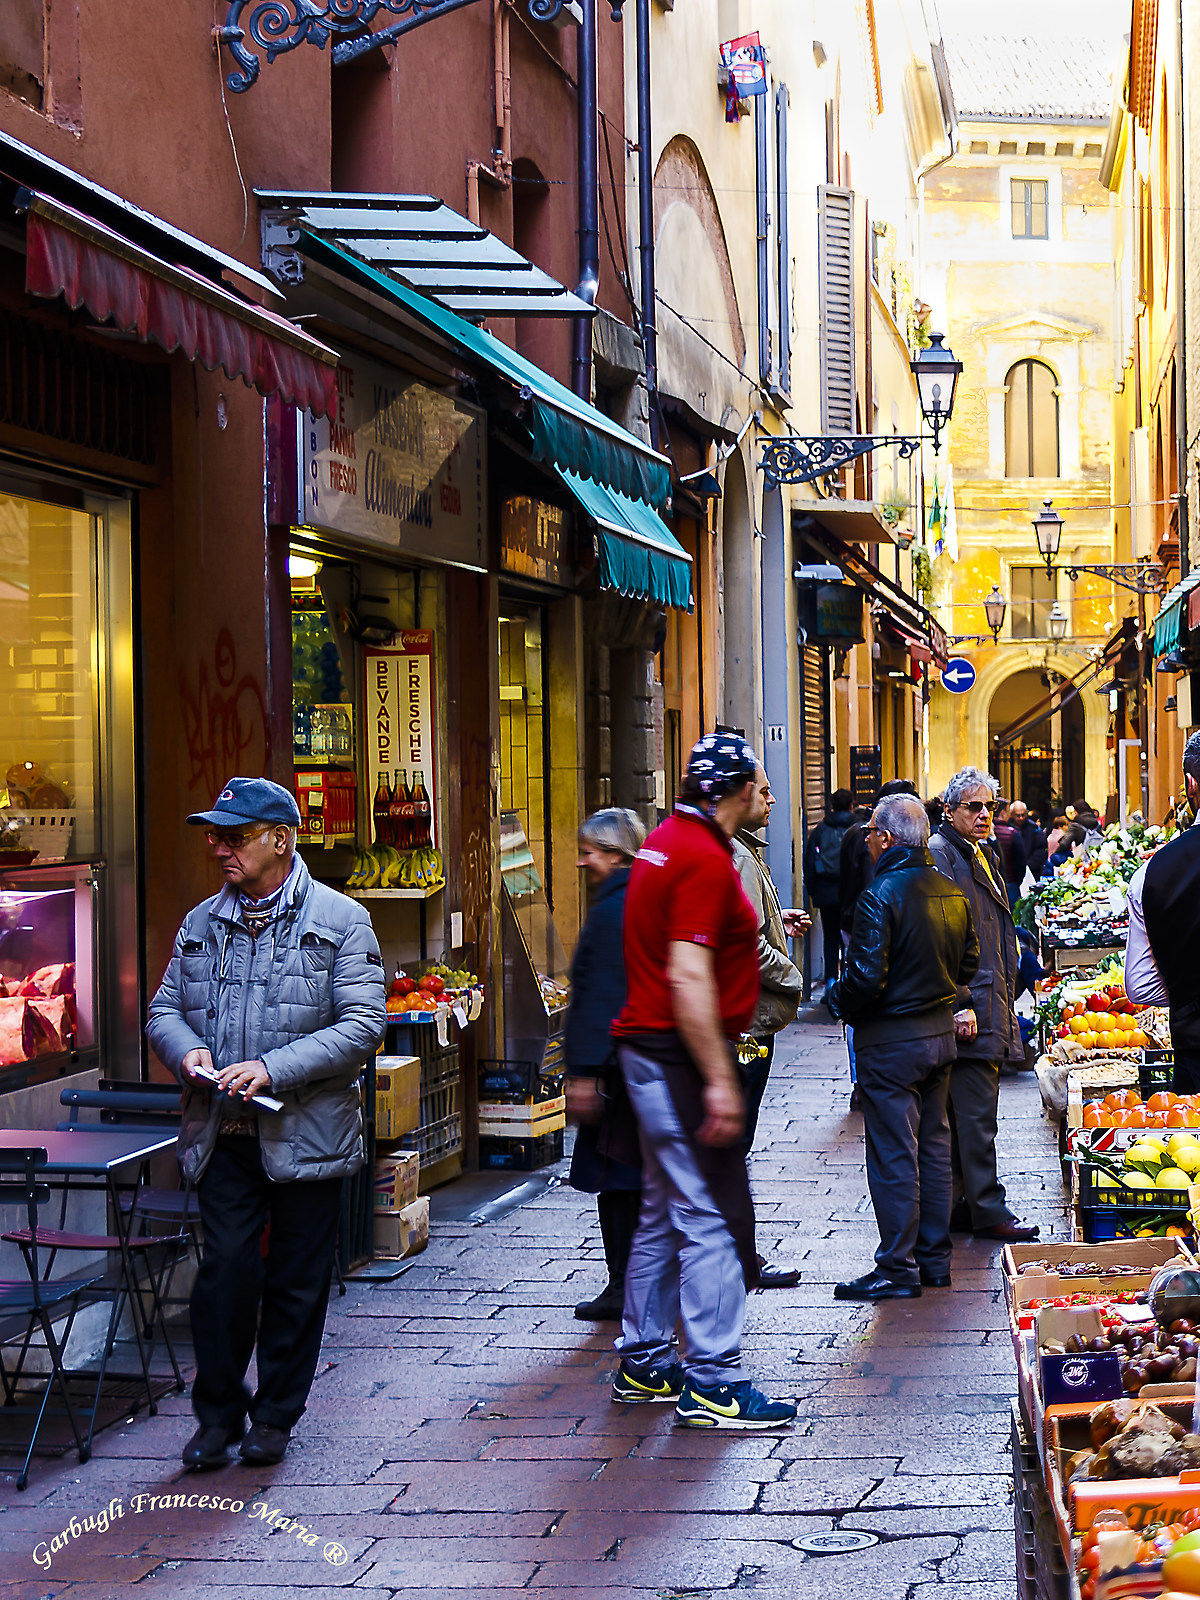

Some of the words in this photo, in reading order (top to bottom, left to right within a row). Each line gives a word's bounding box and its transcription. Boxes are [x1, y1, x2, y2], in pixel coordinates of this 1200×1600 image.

[329, 421, 357, 460] PANNA
[329, 459, 358, 496] FRESCO
[376, 660, 391, 764] BEVANDE
[408, 659, 422, 763] FRESCHE
